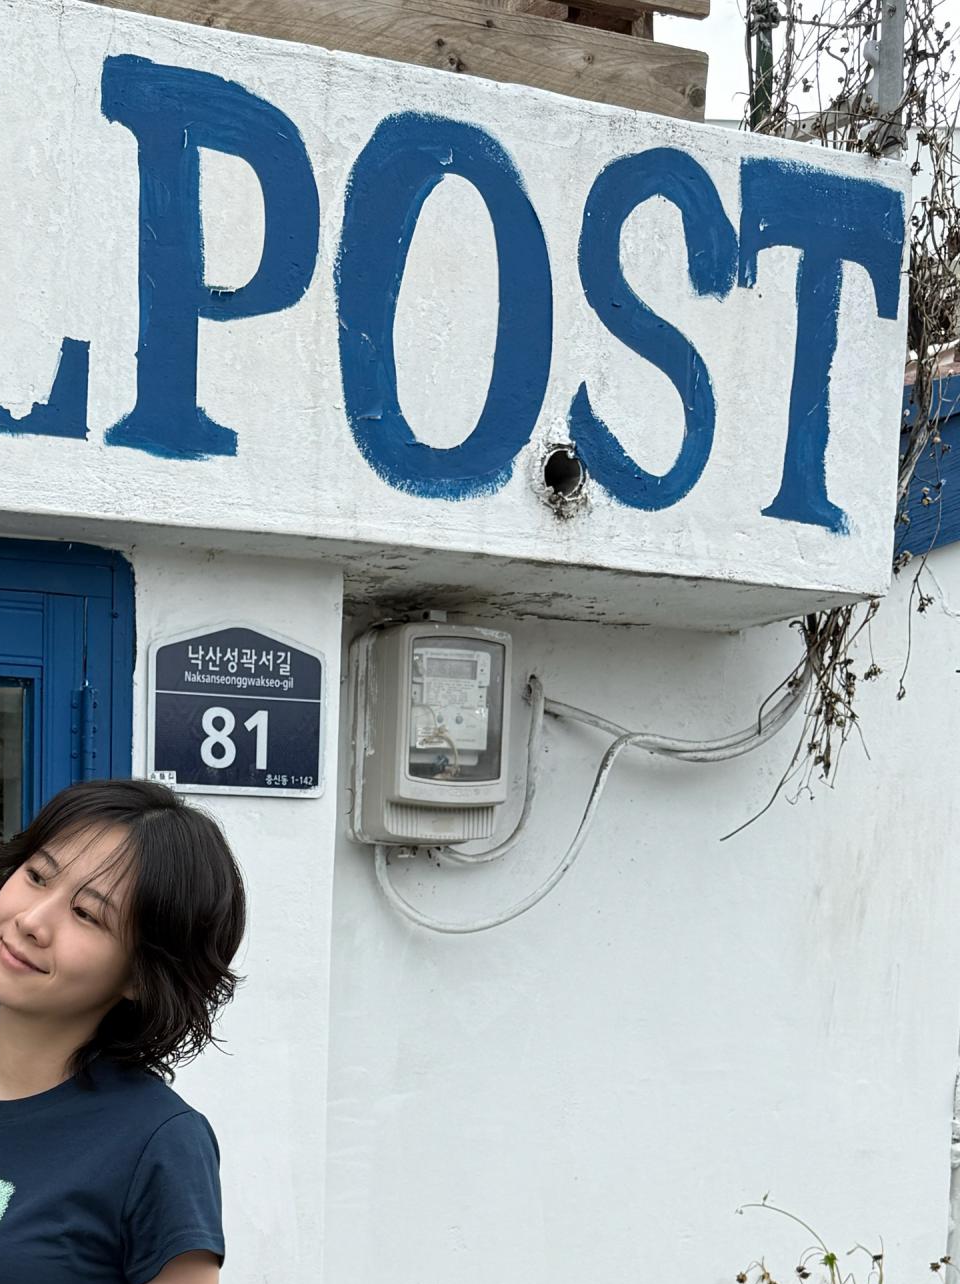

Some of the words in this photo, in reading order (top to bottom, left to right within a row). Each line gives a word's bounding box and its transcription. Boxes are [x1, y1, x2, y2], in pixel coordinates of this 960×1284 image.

[187, 645, 292, 676] 낙산성곽서길
[184, 670, 294, 691] Naksanseonggwakseo-gil
[200, 706, 269, 770] 81
[290, 775, 313, 786] 1-142
